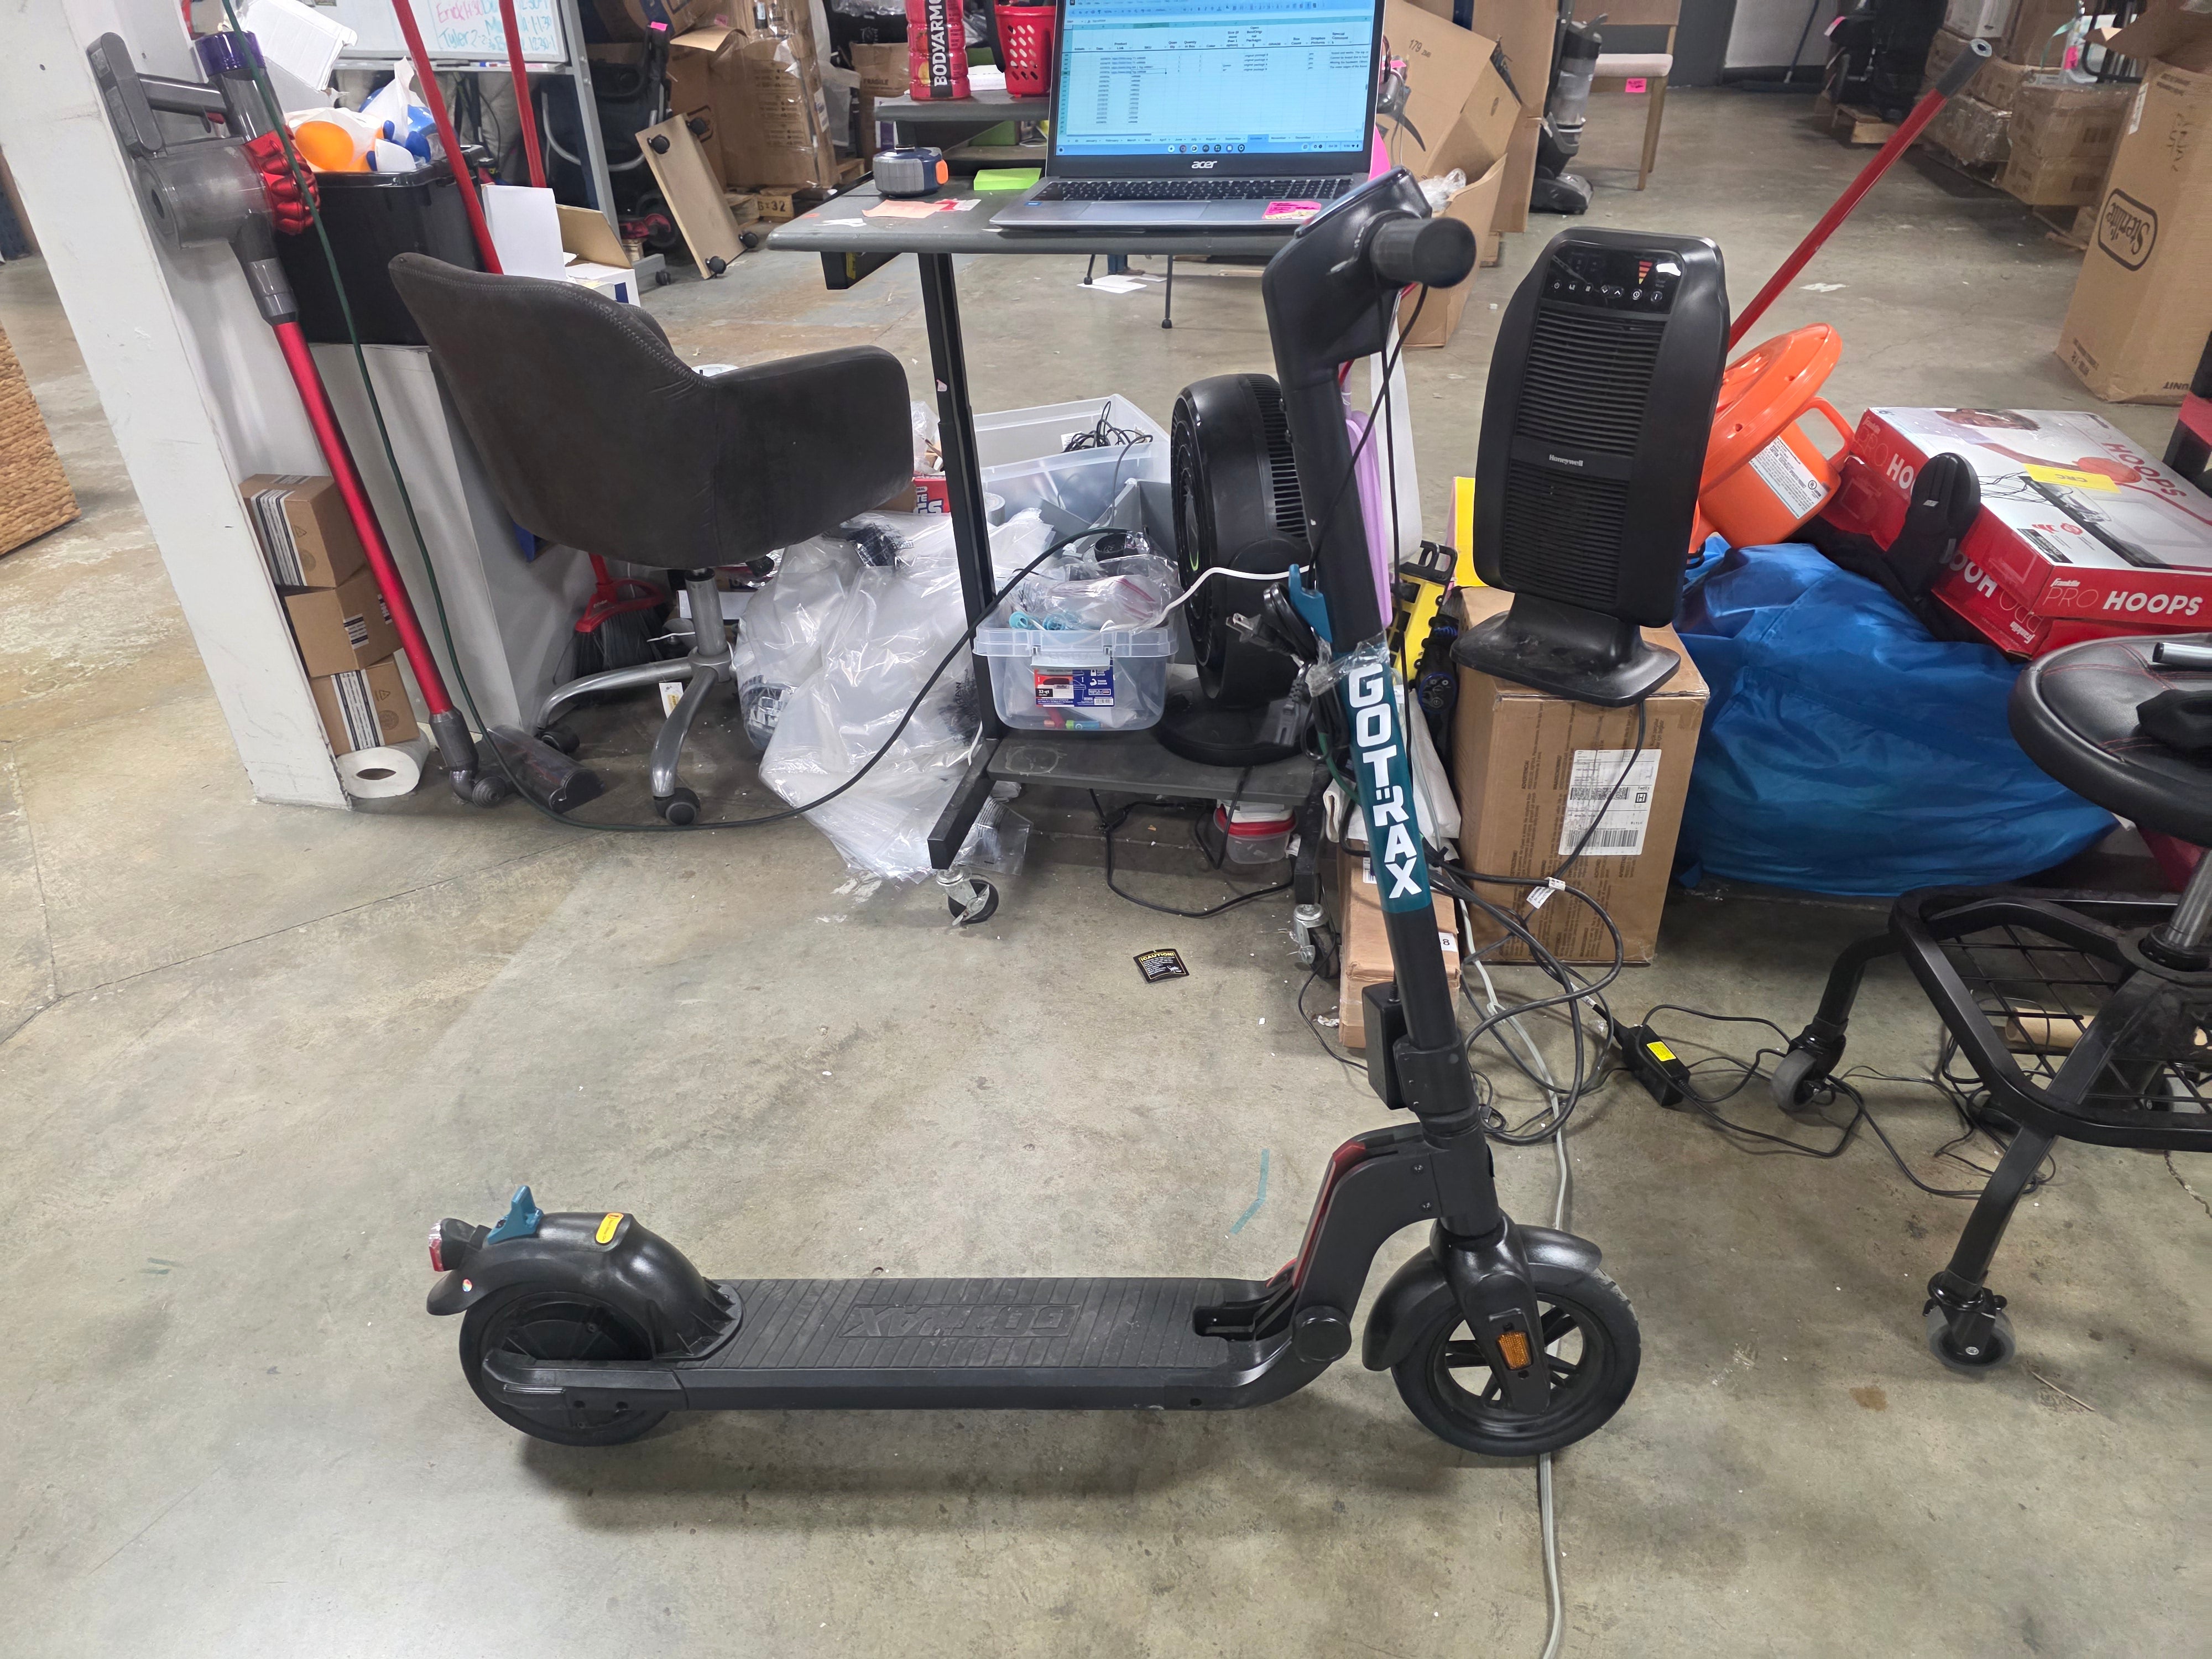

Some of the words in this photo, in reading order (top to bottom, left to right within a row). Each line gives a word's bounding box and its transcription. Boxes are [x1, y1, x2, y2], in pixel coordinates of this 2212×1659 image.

[1409, 39, 1422, 53] 179
[1191, 160, 1218, 169] acer
[2105, 202, 2151, 256] Sterilite
[2163, 382, 2189, 390] UNIT
[1549, 455, 1583, 467] Honeywell
[2103, 443, 2187, 497] HOOPS
[2042, 587, 2099, 608] PRO
[2103, 591, 2203, 615] HOOPS
[1348, 663, 1422, 899] GOTRAX
